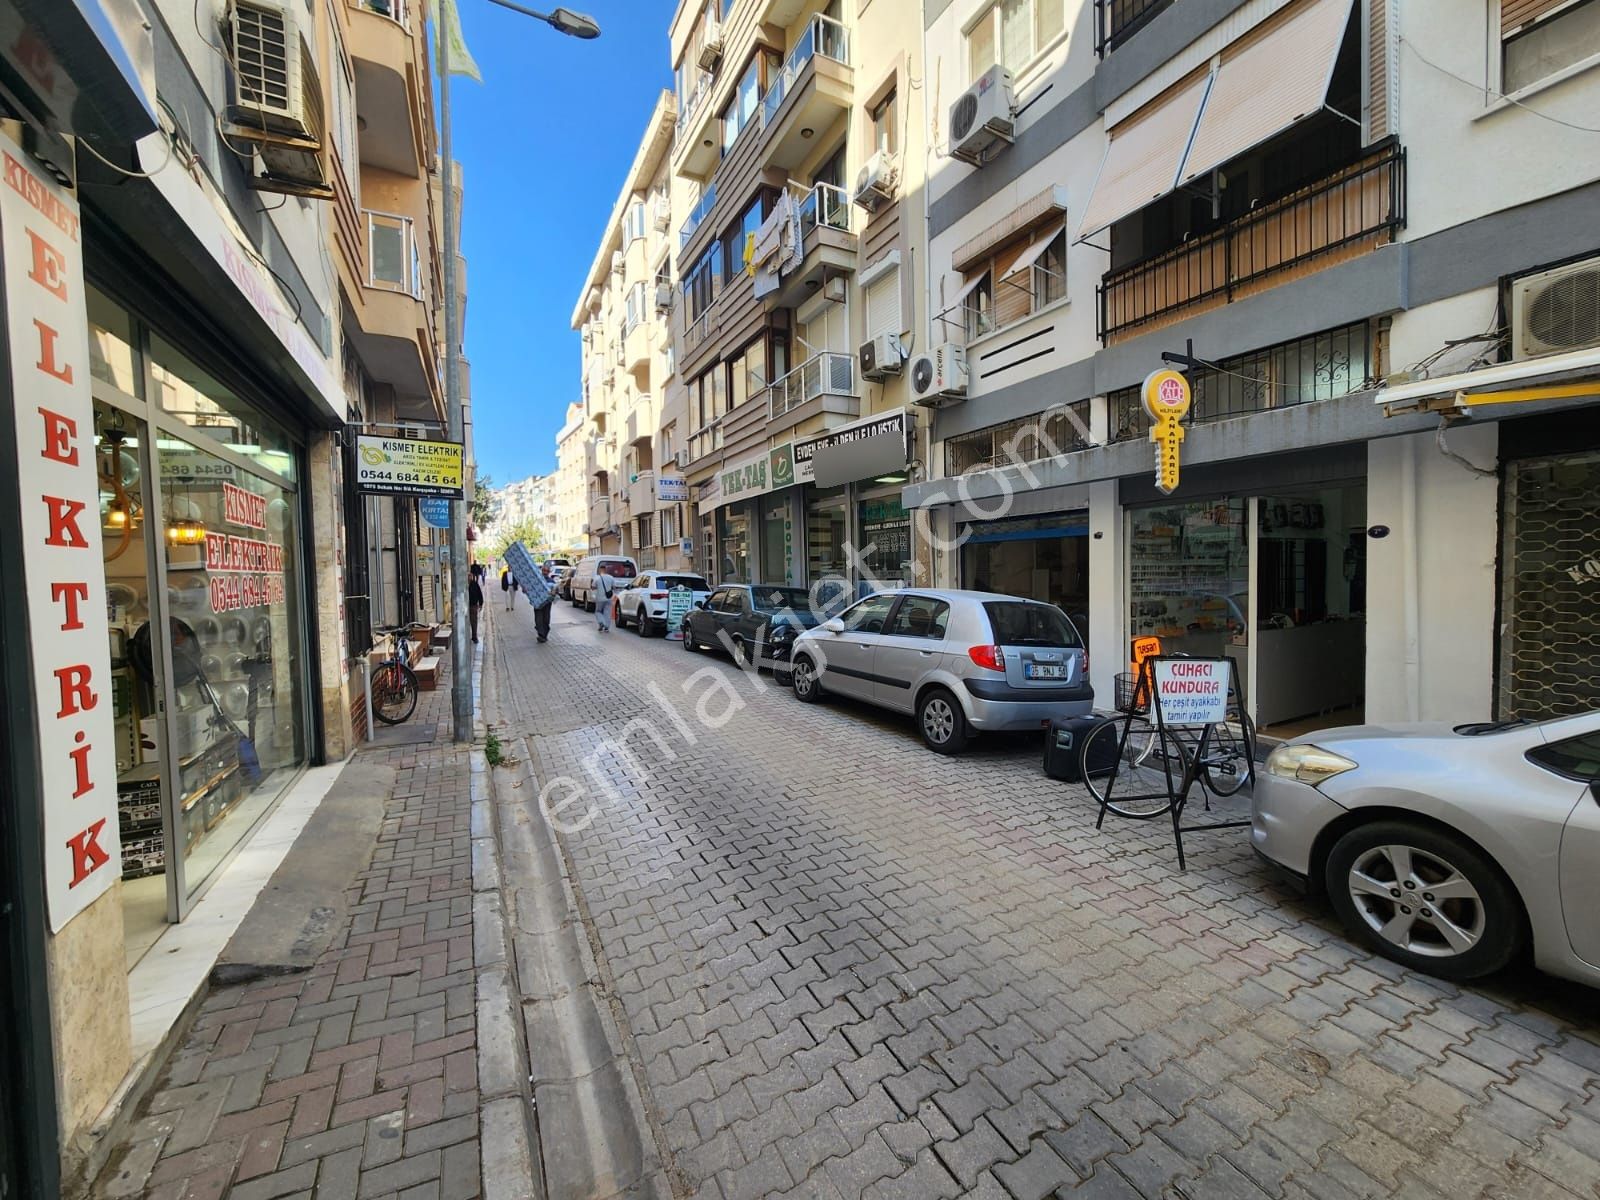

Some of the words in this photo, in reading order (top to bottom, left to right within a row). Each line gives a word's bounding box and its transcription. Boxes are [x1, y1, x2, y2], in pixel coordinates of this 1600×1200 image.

[3, 150, 79, 242] KISMET
[382, 441, 416, 453] KISMET
[360, 470, 392, 480] 0544
[396, 472, 419, 482] 684
[423, 474, 438, 484] 45
[442, 476, 457, 485] 64
[223, 481, 266, 530] KISMET
[25, 225, 110, 889] ELEKTRİK
[205, 531, 283, 573] ELEKTRİK
[210, 576, 241, 613] 0544
[242, 575, 261, 609] 684
[1162, 681, 1219, 694] KUNDURA
[1171, 663, 1213, 679] ÇUHACI
